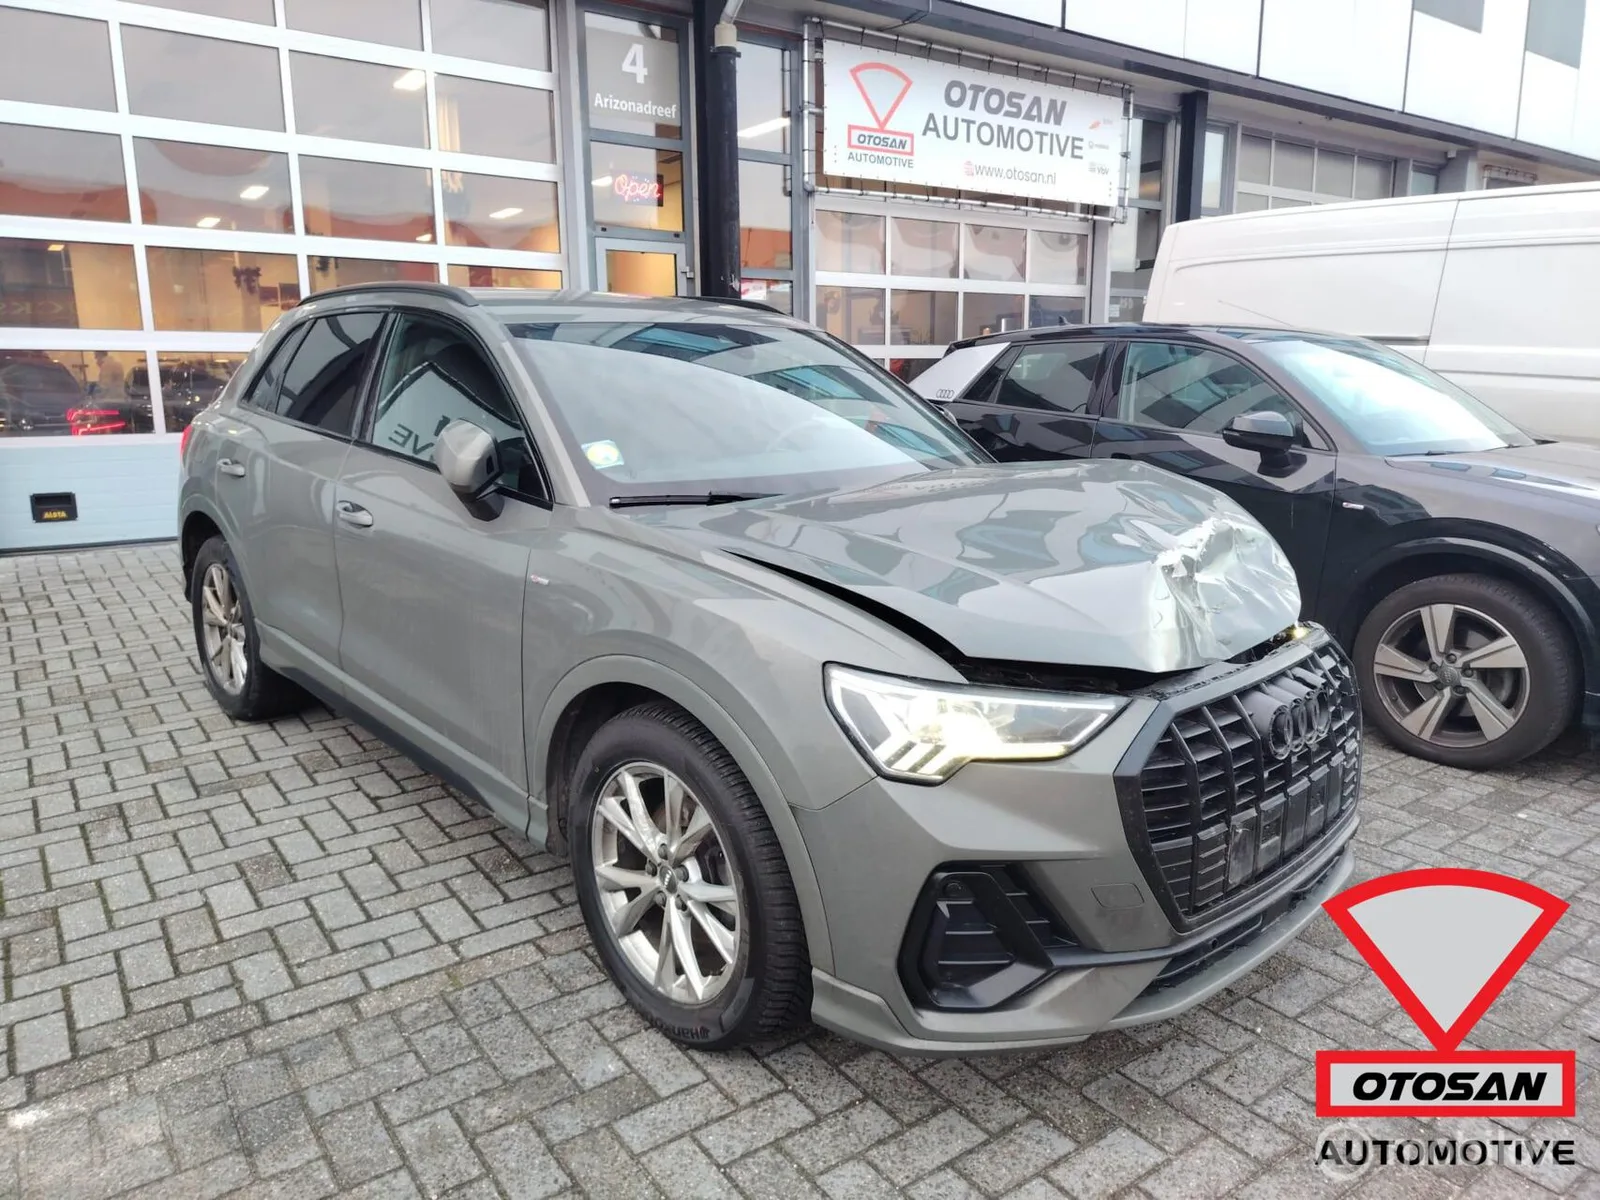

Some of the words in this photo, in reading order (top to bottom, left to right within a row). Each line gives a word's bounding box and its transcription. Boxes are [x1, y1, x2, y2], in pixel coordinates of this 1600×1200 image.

[621, 43, 648, 84] 4
[594, 92, 677, 119] Arizonadreef
[944, 80, 1067, 126] OTOSAN
[857, 133, 908, 150] OTOSAN
[922, 113, 1084, 160] AUTOMOTIVE
[847, 151, 914, 169] AUTOMOTIVE
[614, 173, 661, 202] Open
[974, 164, 1057, 185] www.otosan.nl
